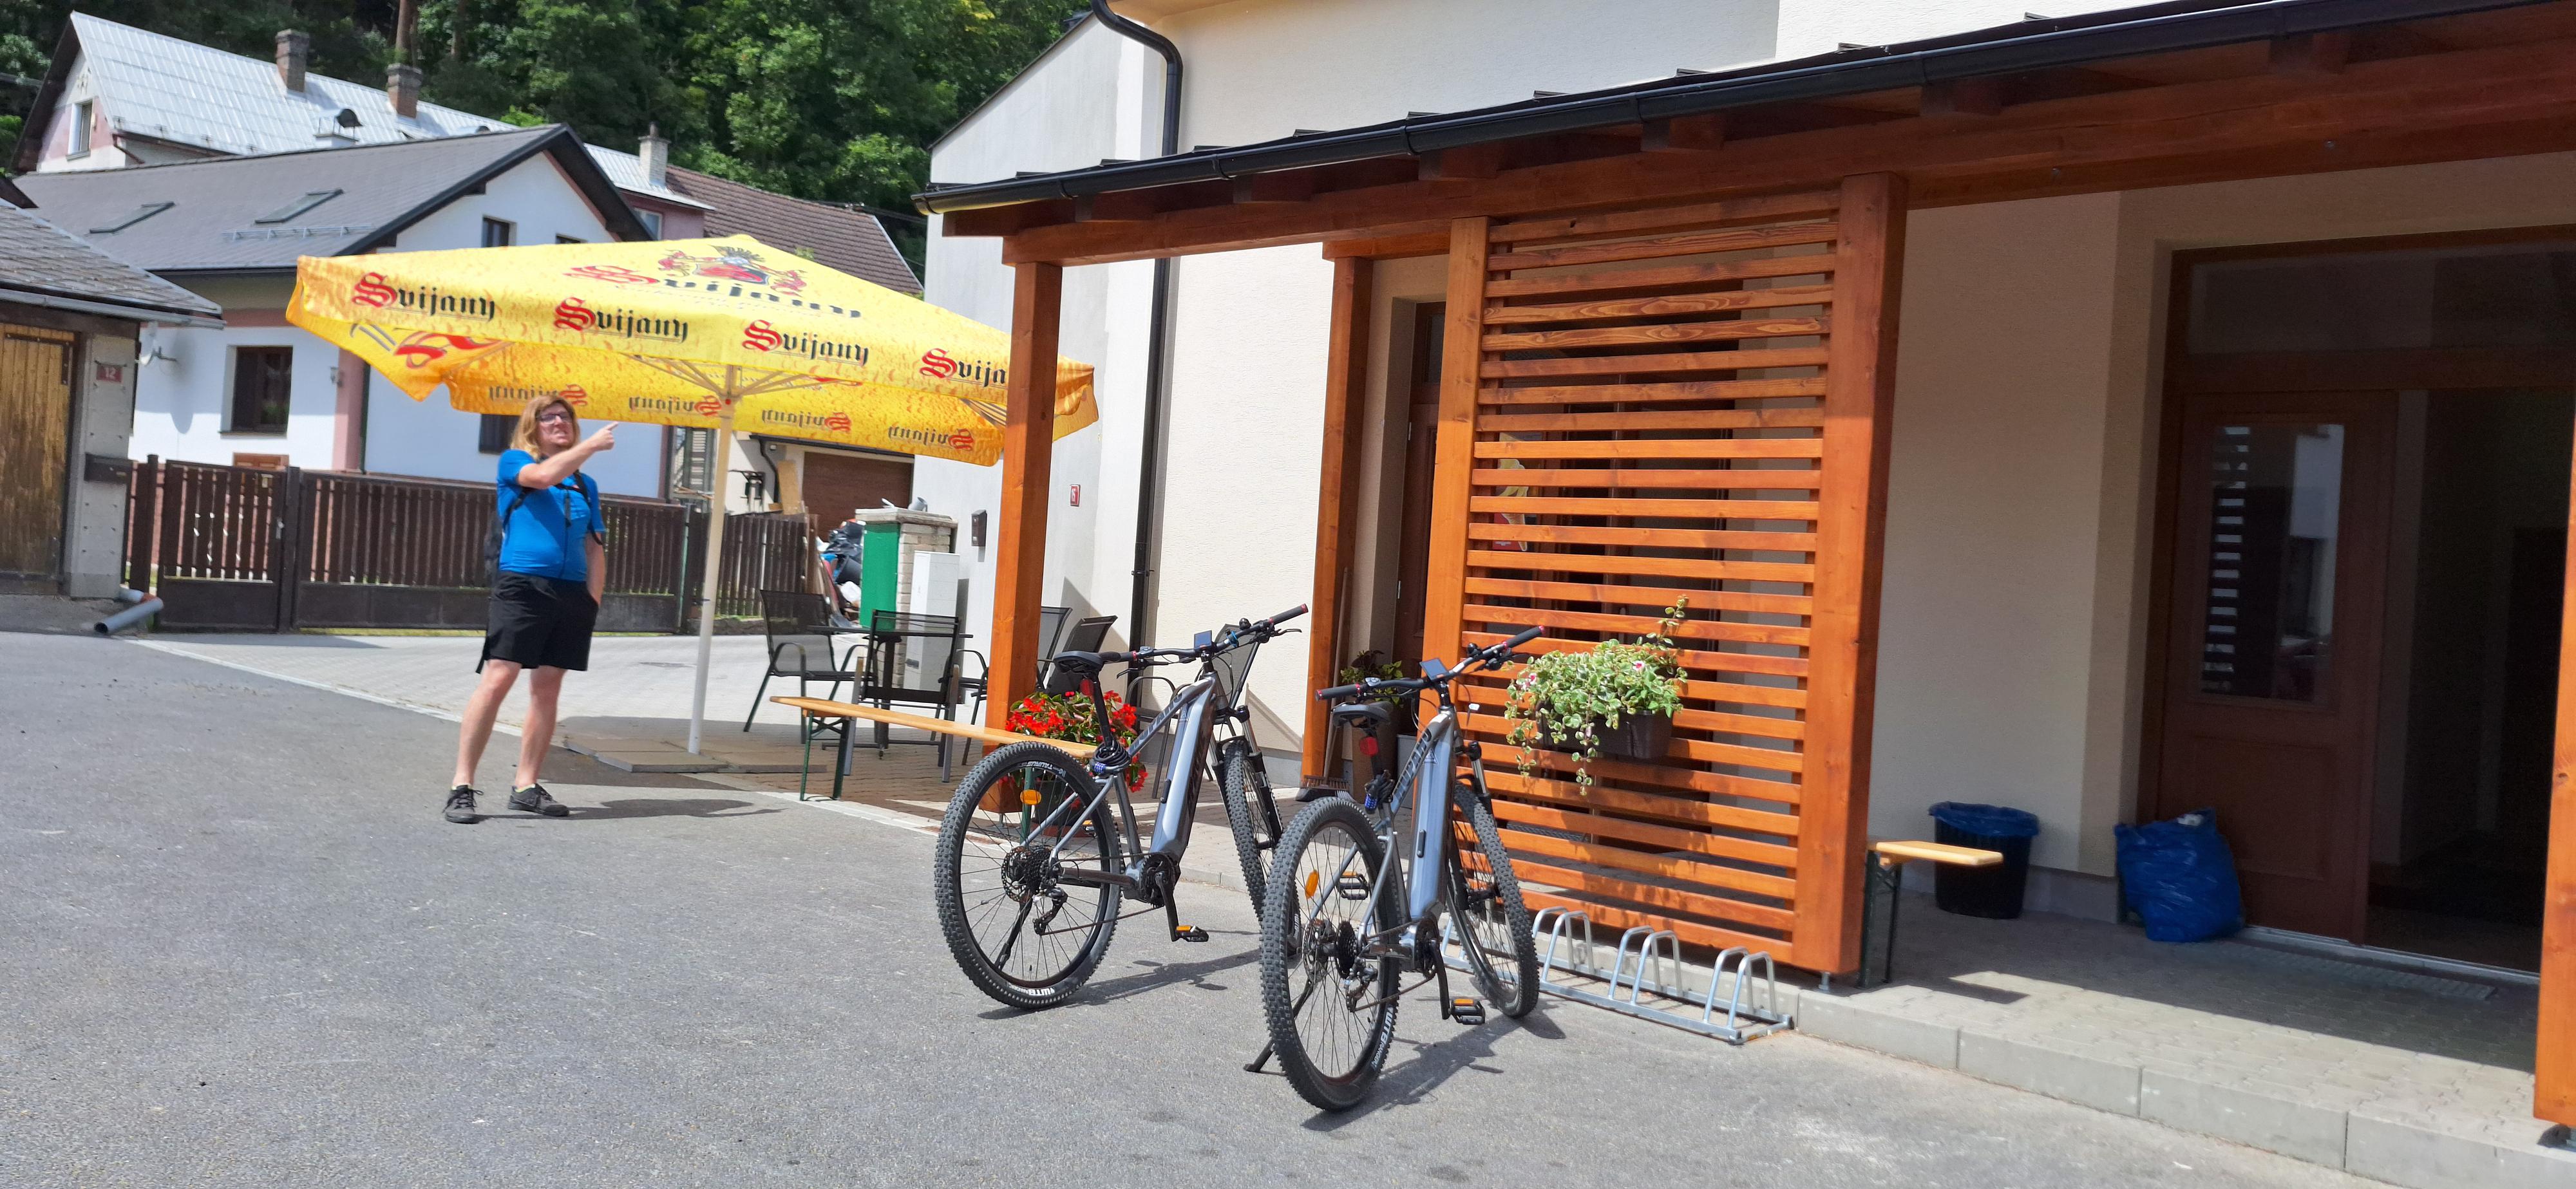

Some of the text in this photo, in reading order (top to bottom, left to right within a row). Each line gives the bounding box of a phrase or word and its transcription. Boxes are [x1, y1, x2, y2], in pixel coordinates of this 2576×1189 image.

[352, 272, 495, 321] Svijany
[562, 265, 862, 319] Svijany
[554, 297, 688, 342] Svijany
[742, 319, 869, 366] Svijany
[104, 367, 116, 379] 12
[919, 348, 1007, 388] Svija
[1028, 987, 1052, 996] WTB
[1380, 1011, 1394, 1044] WTB
